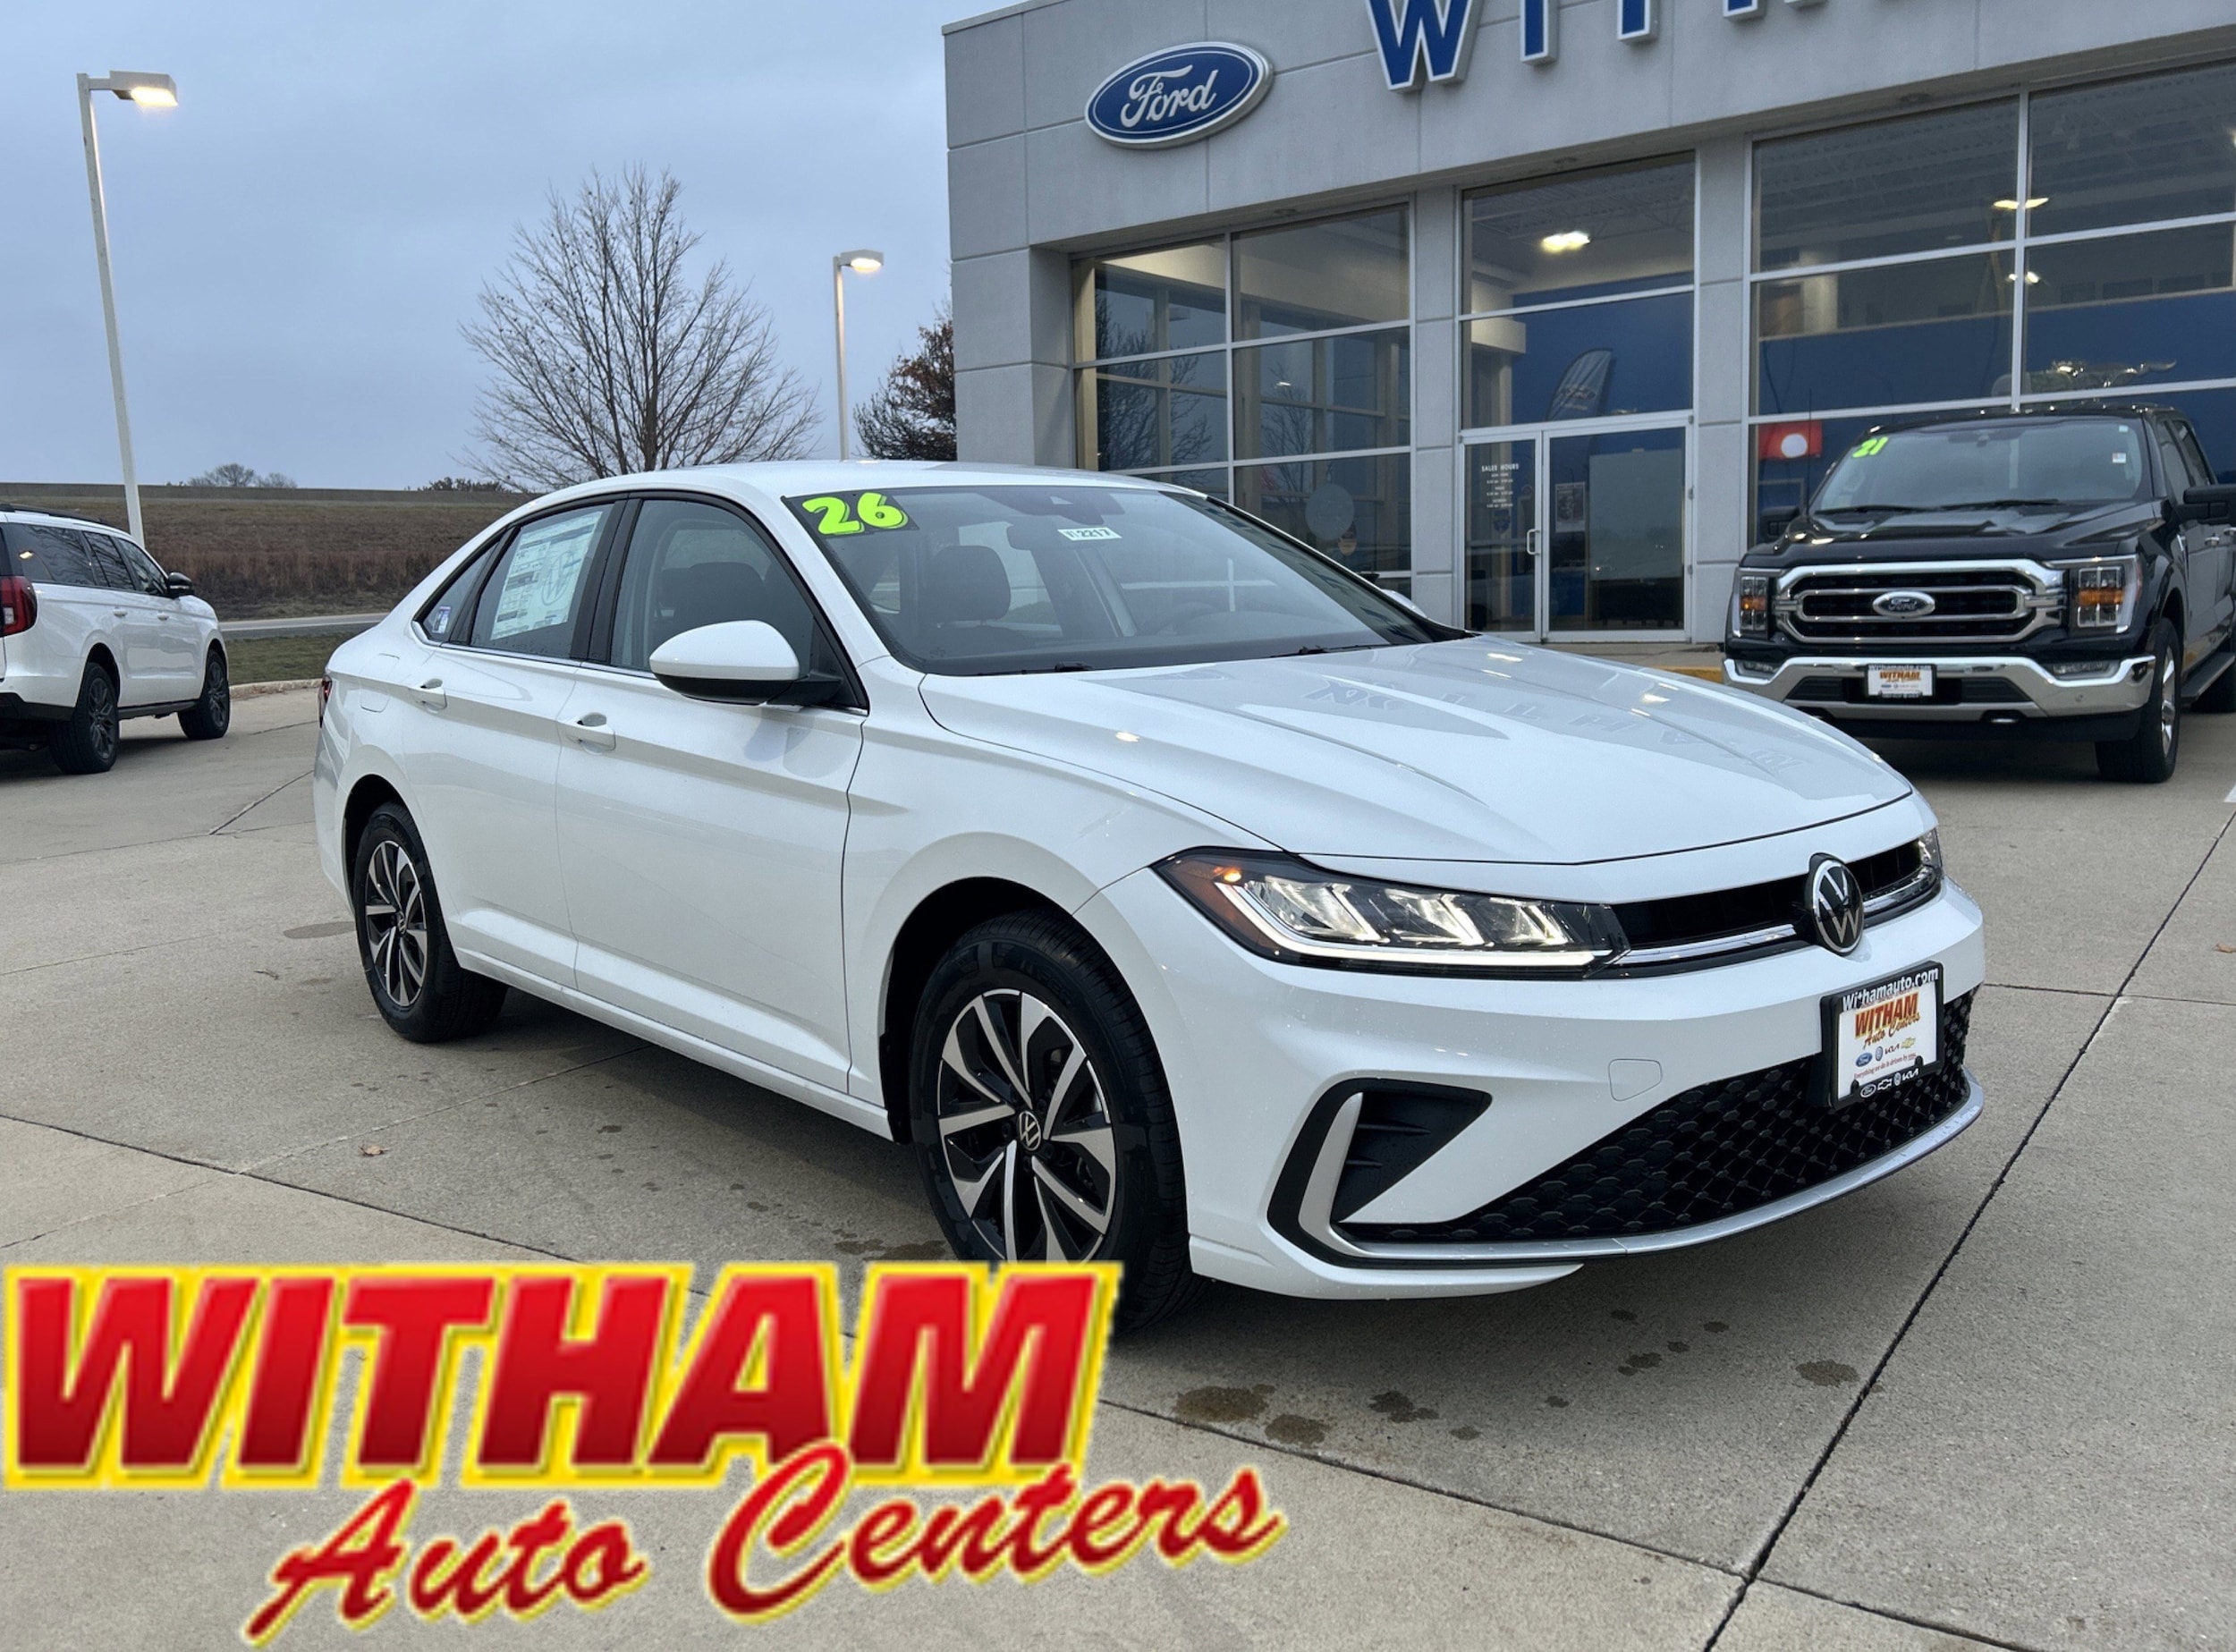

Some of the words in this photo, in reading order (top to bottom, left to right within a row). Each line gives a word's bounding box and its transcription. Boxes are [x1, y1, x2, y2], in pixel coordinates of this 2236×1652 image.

[1120, 64, 1219, 128] Ford
[1852, 436, 1889, 459] 21
[801, 492, 909, 535] 26
[1888, 597, 1918, 611] Ford
[1842, 968, 1939, 1012] Withamauto.com
[1855, 992, 1919, 1038] WITHAM
[1863, 1028, 1885, 1050] Auto
